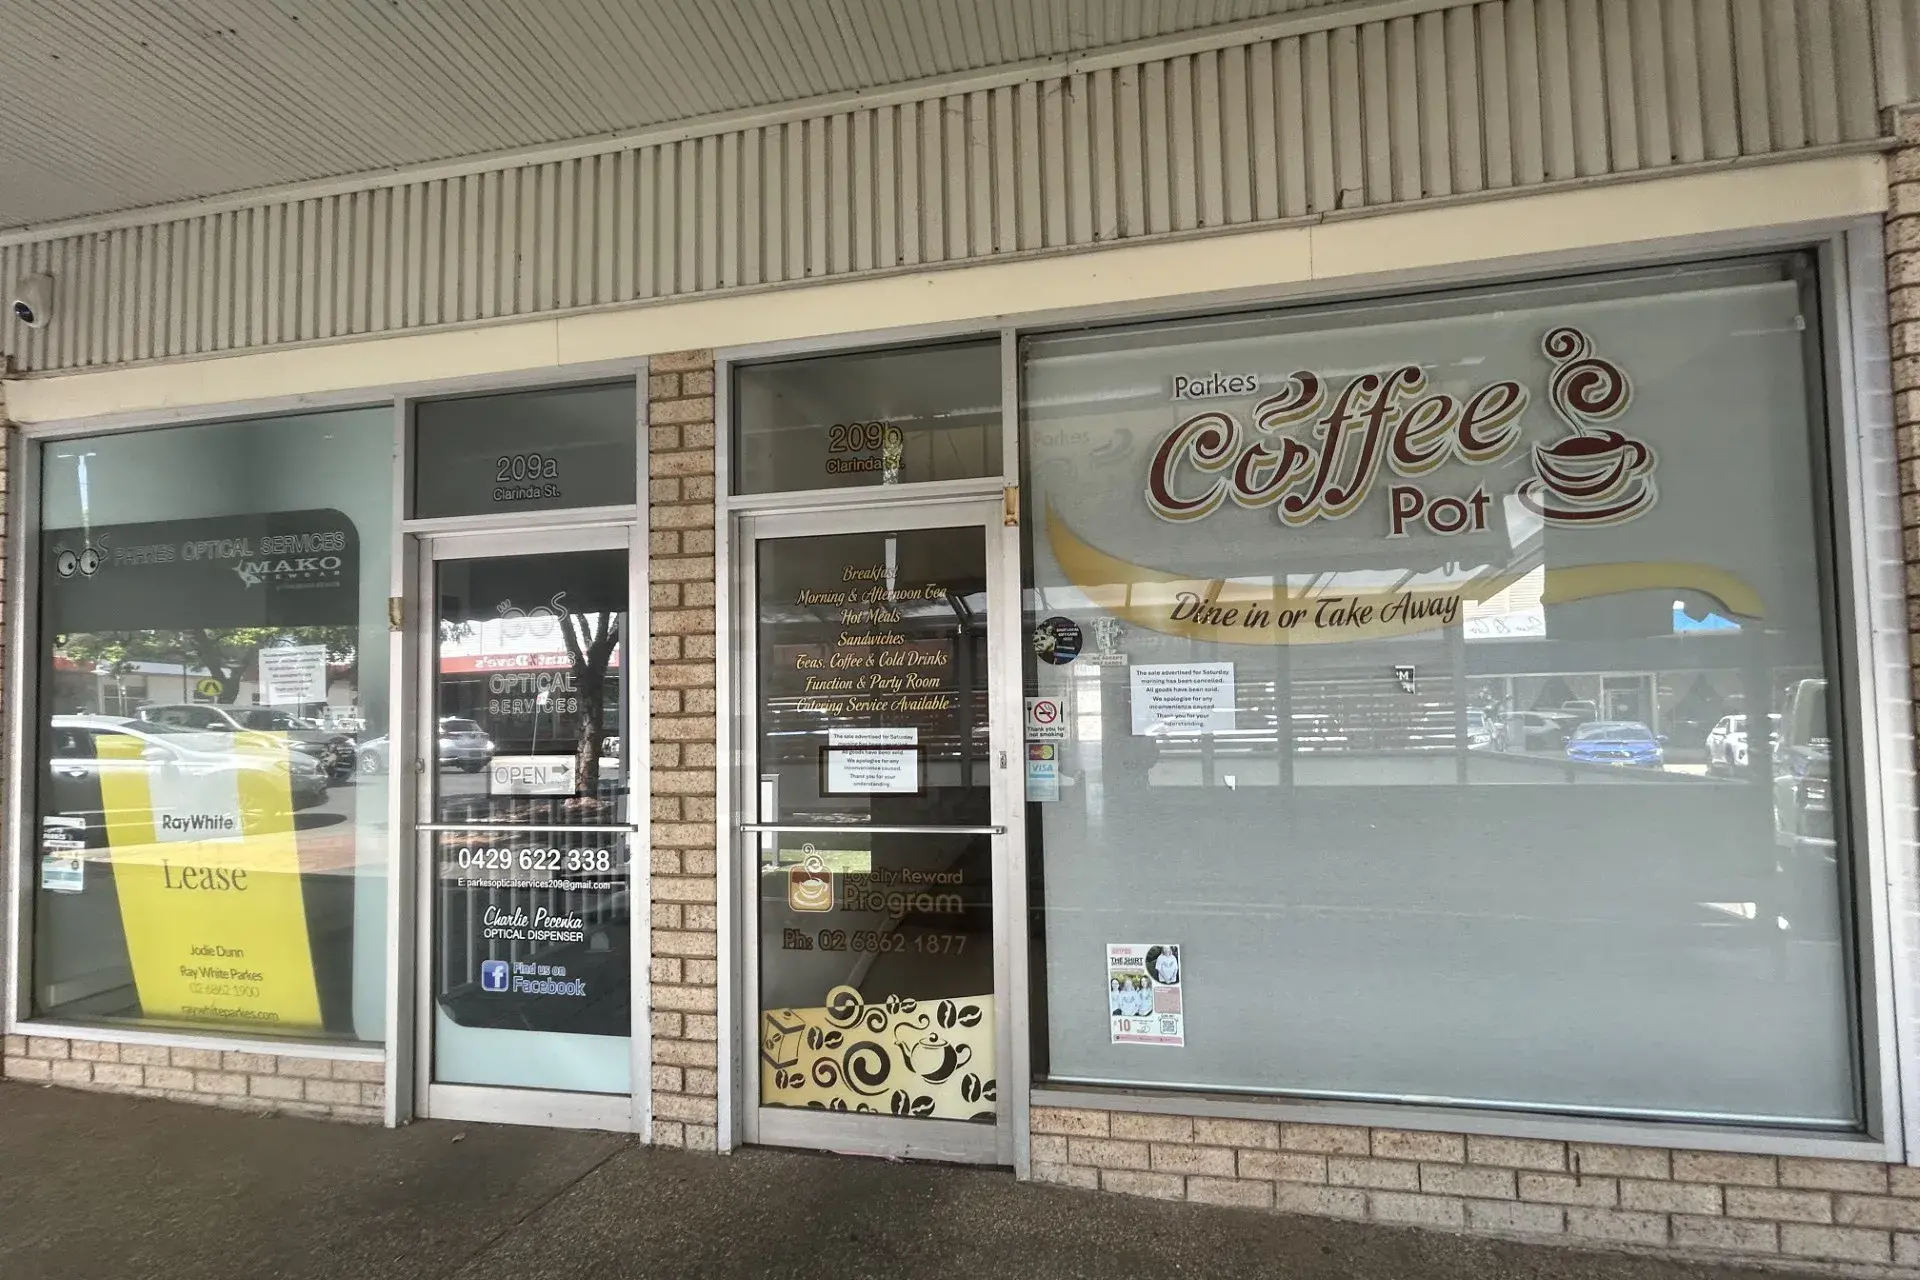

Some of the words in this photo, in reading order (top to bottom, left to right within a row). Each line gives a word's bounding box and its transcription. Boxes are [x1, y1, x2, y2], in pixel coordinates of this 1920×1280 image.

[1173, 371, 1257, 398] Parkes
[829, 421, 903, 453] 209b
[1146, 364, 1528, 525] Coffee
[496, 453, 558, 482] 209a
[826, 456, 883, 474] Clarinda
[493, 486, 541, 502] Clarinda
[544, 484, 561, 498] St.
[1388, 484, 1491, 536] Pot
[182, 538, 253, 561] OPTICAL
[261, 532, 345, 555] SERVICES
[246, 556, 341, 573] MAKO
[842, 564, 899, 581] Breakfast
[797, 588, 845, 607] Morning
[849, 588, 858, 601] &
[861, 586, 922, 603] Afternoon
[925, 583, 948, 599] Tea
[840, 608, 863, 625] Hot
[866, 608, 901, 625] Meals
[1170, 591, 1236, 626] Dine
[1244, 602, 1270, 628] in
[1277, 610, 1306, 628] or
[1314, 596, 1373, 628] Take
[1380, 591, 1460, 624] Away
[837, 631, 905, 647] Sandwiches
[830, 652, 863, 670] Coffee
[865, 653, 875, 667] &
[879, 650, 905, 667] Cold
[907, 650, 948, 667] Drinks
[489, 672, 577, 694] OPTICAL
[805, 676, 853, 692] Function
[856, 675, 866, 689] &
[869, 674, 903, 692] Party
[906, 673, 940, 689] Room
[489, 698, 578, 714] SERVICES
[797, 696, 843, 716] Catering
[846, 696, 888, 712] Service
[890, 695, 950, 711] Available
[495, 767, 546, 784] OPEN
[1032, 764, 1053, 772] VISA
[163, 815, 233, 832] RayWhite
[458, 848, 512, 869] 0429
[519, 849, 561, 870] 622
[567, 849, 610, 871] 338
[161, 859, 248, 891] Lease
[467, 878, 610, 891] parkesopticalservices209@gmail.com
[842, 866, 898, 886] Loyalty
[902, 868, 963, 884] Reward
[841, 884, 963, 919] Program
[484, 905, 529, 927] Charlie
[534, 907, 583, 929] Pecenka
[484, 928, 525, 940] OPTICAL
[528, 929, 583, 942] DISPENSER
[782, 928, 814, 950] Ph:
[818, 929, 846, 951] 02
[850, 929, 906, 953] 6862
[914, 934, 967, 955] 1877
[191, 944, 215, 956] Jodie
[216, 945, 244, 958] Dunn
[180, 965, 197, 979] Ray
[199, 966, 229, 979] White
[230, 968, 264, 981] Parkes
[513, 962, 536, 974] Find
[538, 965, 550, 975] us
[552, 966, 566, 976] on
[513, 976, 586, 996] Facebook
